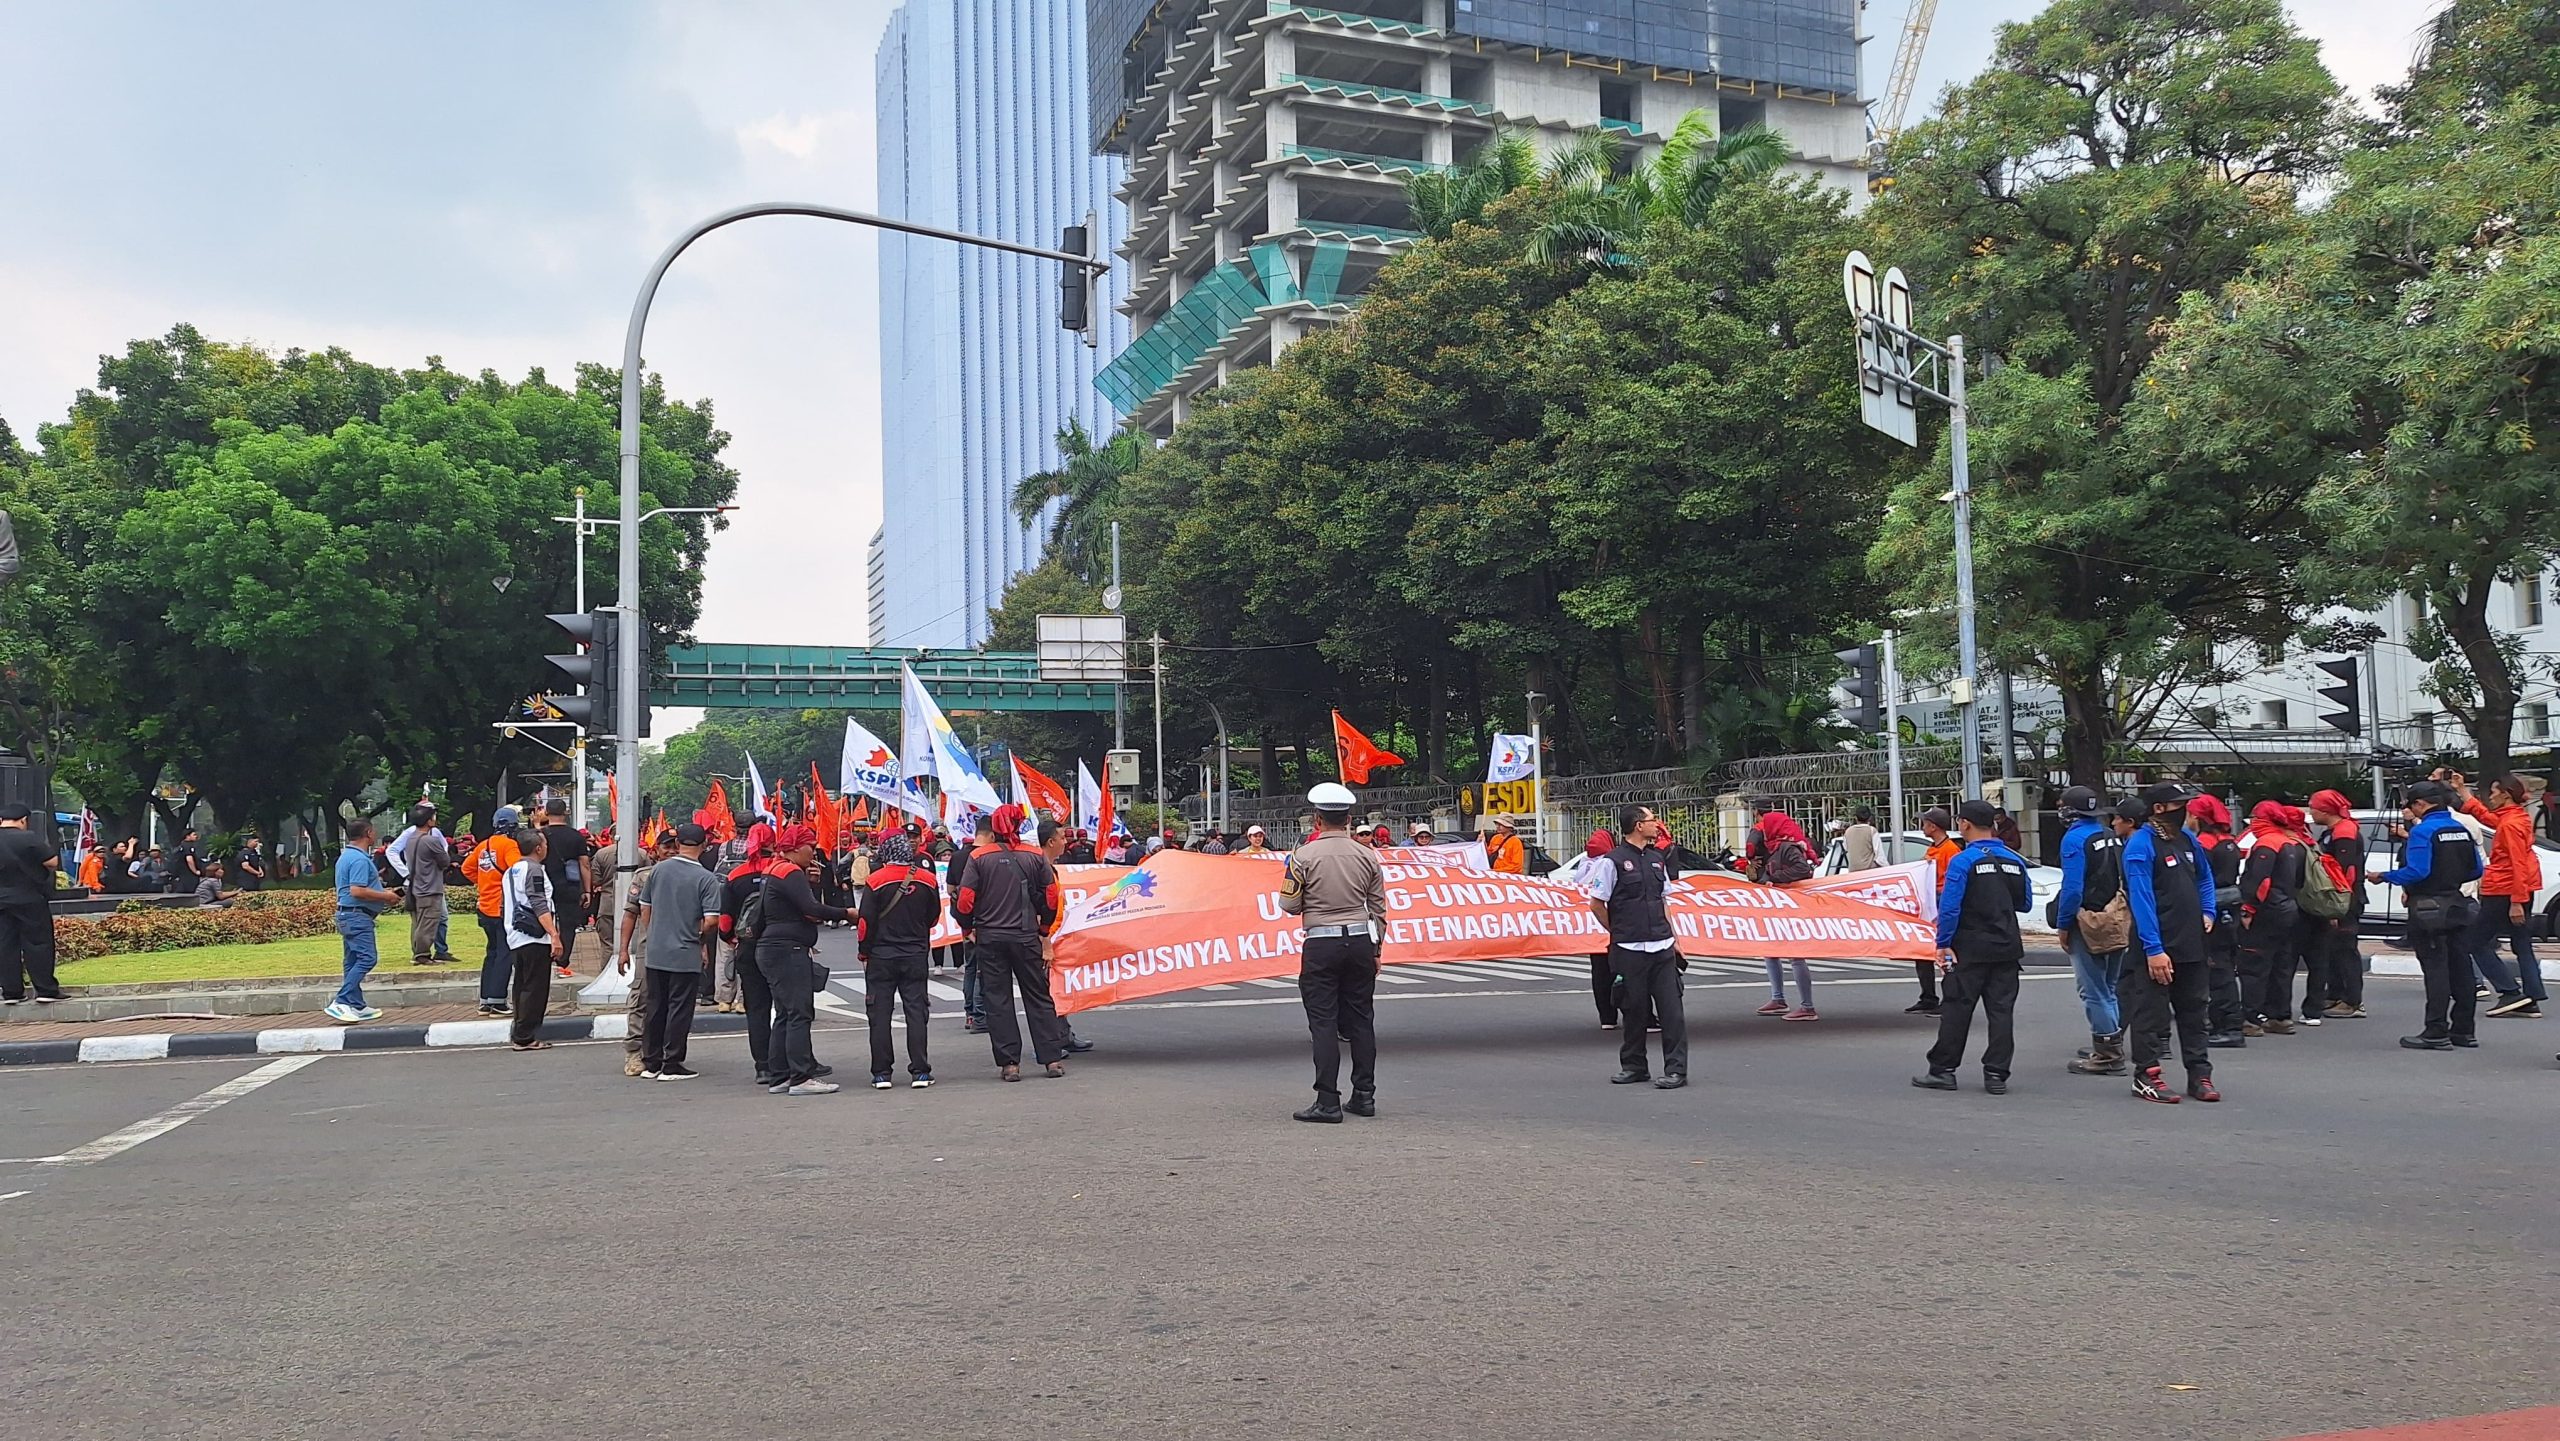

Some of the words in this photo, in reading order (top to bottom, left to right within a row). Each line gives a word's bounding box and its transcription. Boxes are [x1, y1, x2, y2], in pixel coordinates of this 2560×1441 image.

[854, 767, 897, 788] KSPI
[1088, 814, 1126, 835] KPI
[1694, 887, 1800, 910] KERJA
[1086, 899, 1127, 920] KSPI
[1063, 936, 1232, 995] KHUSUSNYA
[1237, 927, 1307, 962] KLAS
[1702, 912, 1896, 943] PERLINDUNGAN
